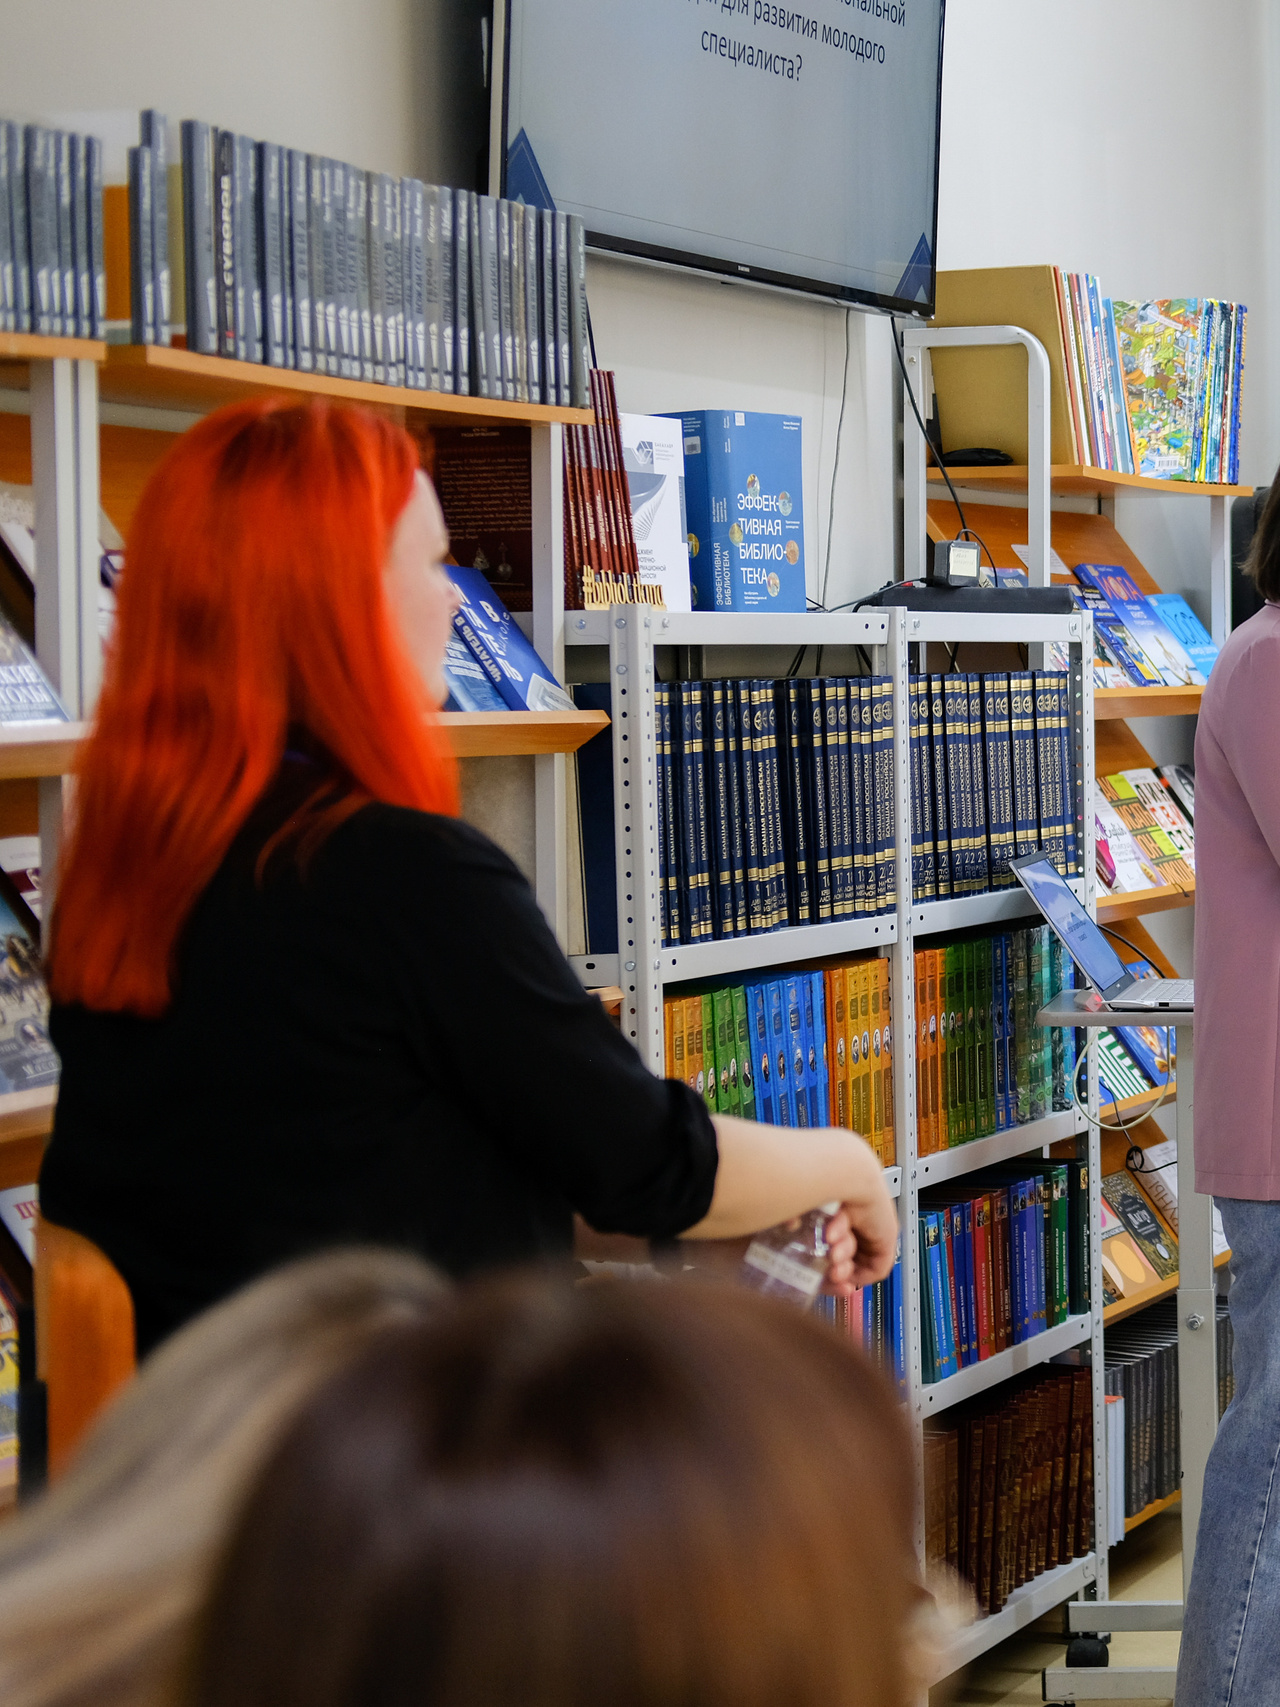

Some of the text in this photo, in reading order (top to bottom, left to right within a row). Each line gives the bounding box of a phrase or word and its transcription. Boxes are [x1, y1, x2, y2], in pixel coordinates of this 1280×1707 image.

[700, 30, 803, 82] специалиста?
[753, 0, 818, 40] развития
[821, 24, 886, 64] молодого
[220, 175, 234, 286] СУВОРОВ
[737, 493, 780, 512] ЭФФЕК-
[738, 517, 782, 536] ТИВНАЯ
[713, 542, 724, 606] ЭФФЕКТИВНАЯ
[722, 549, 732, 606] БИБЛИОТЕКА
[739, 542, 787, 561] БИБЛИО-
[740, 567, 768, 585] ТЕКА
[463, 624, 501, 683] ЧИТАТЕЛЬ
